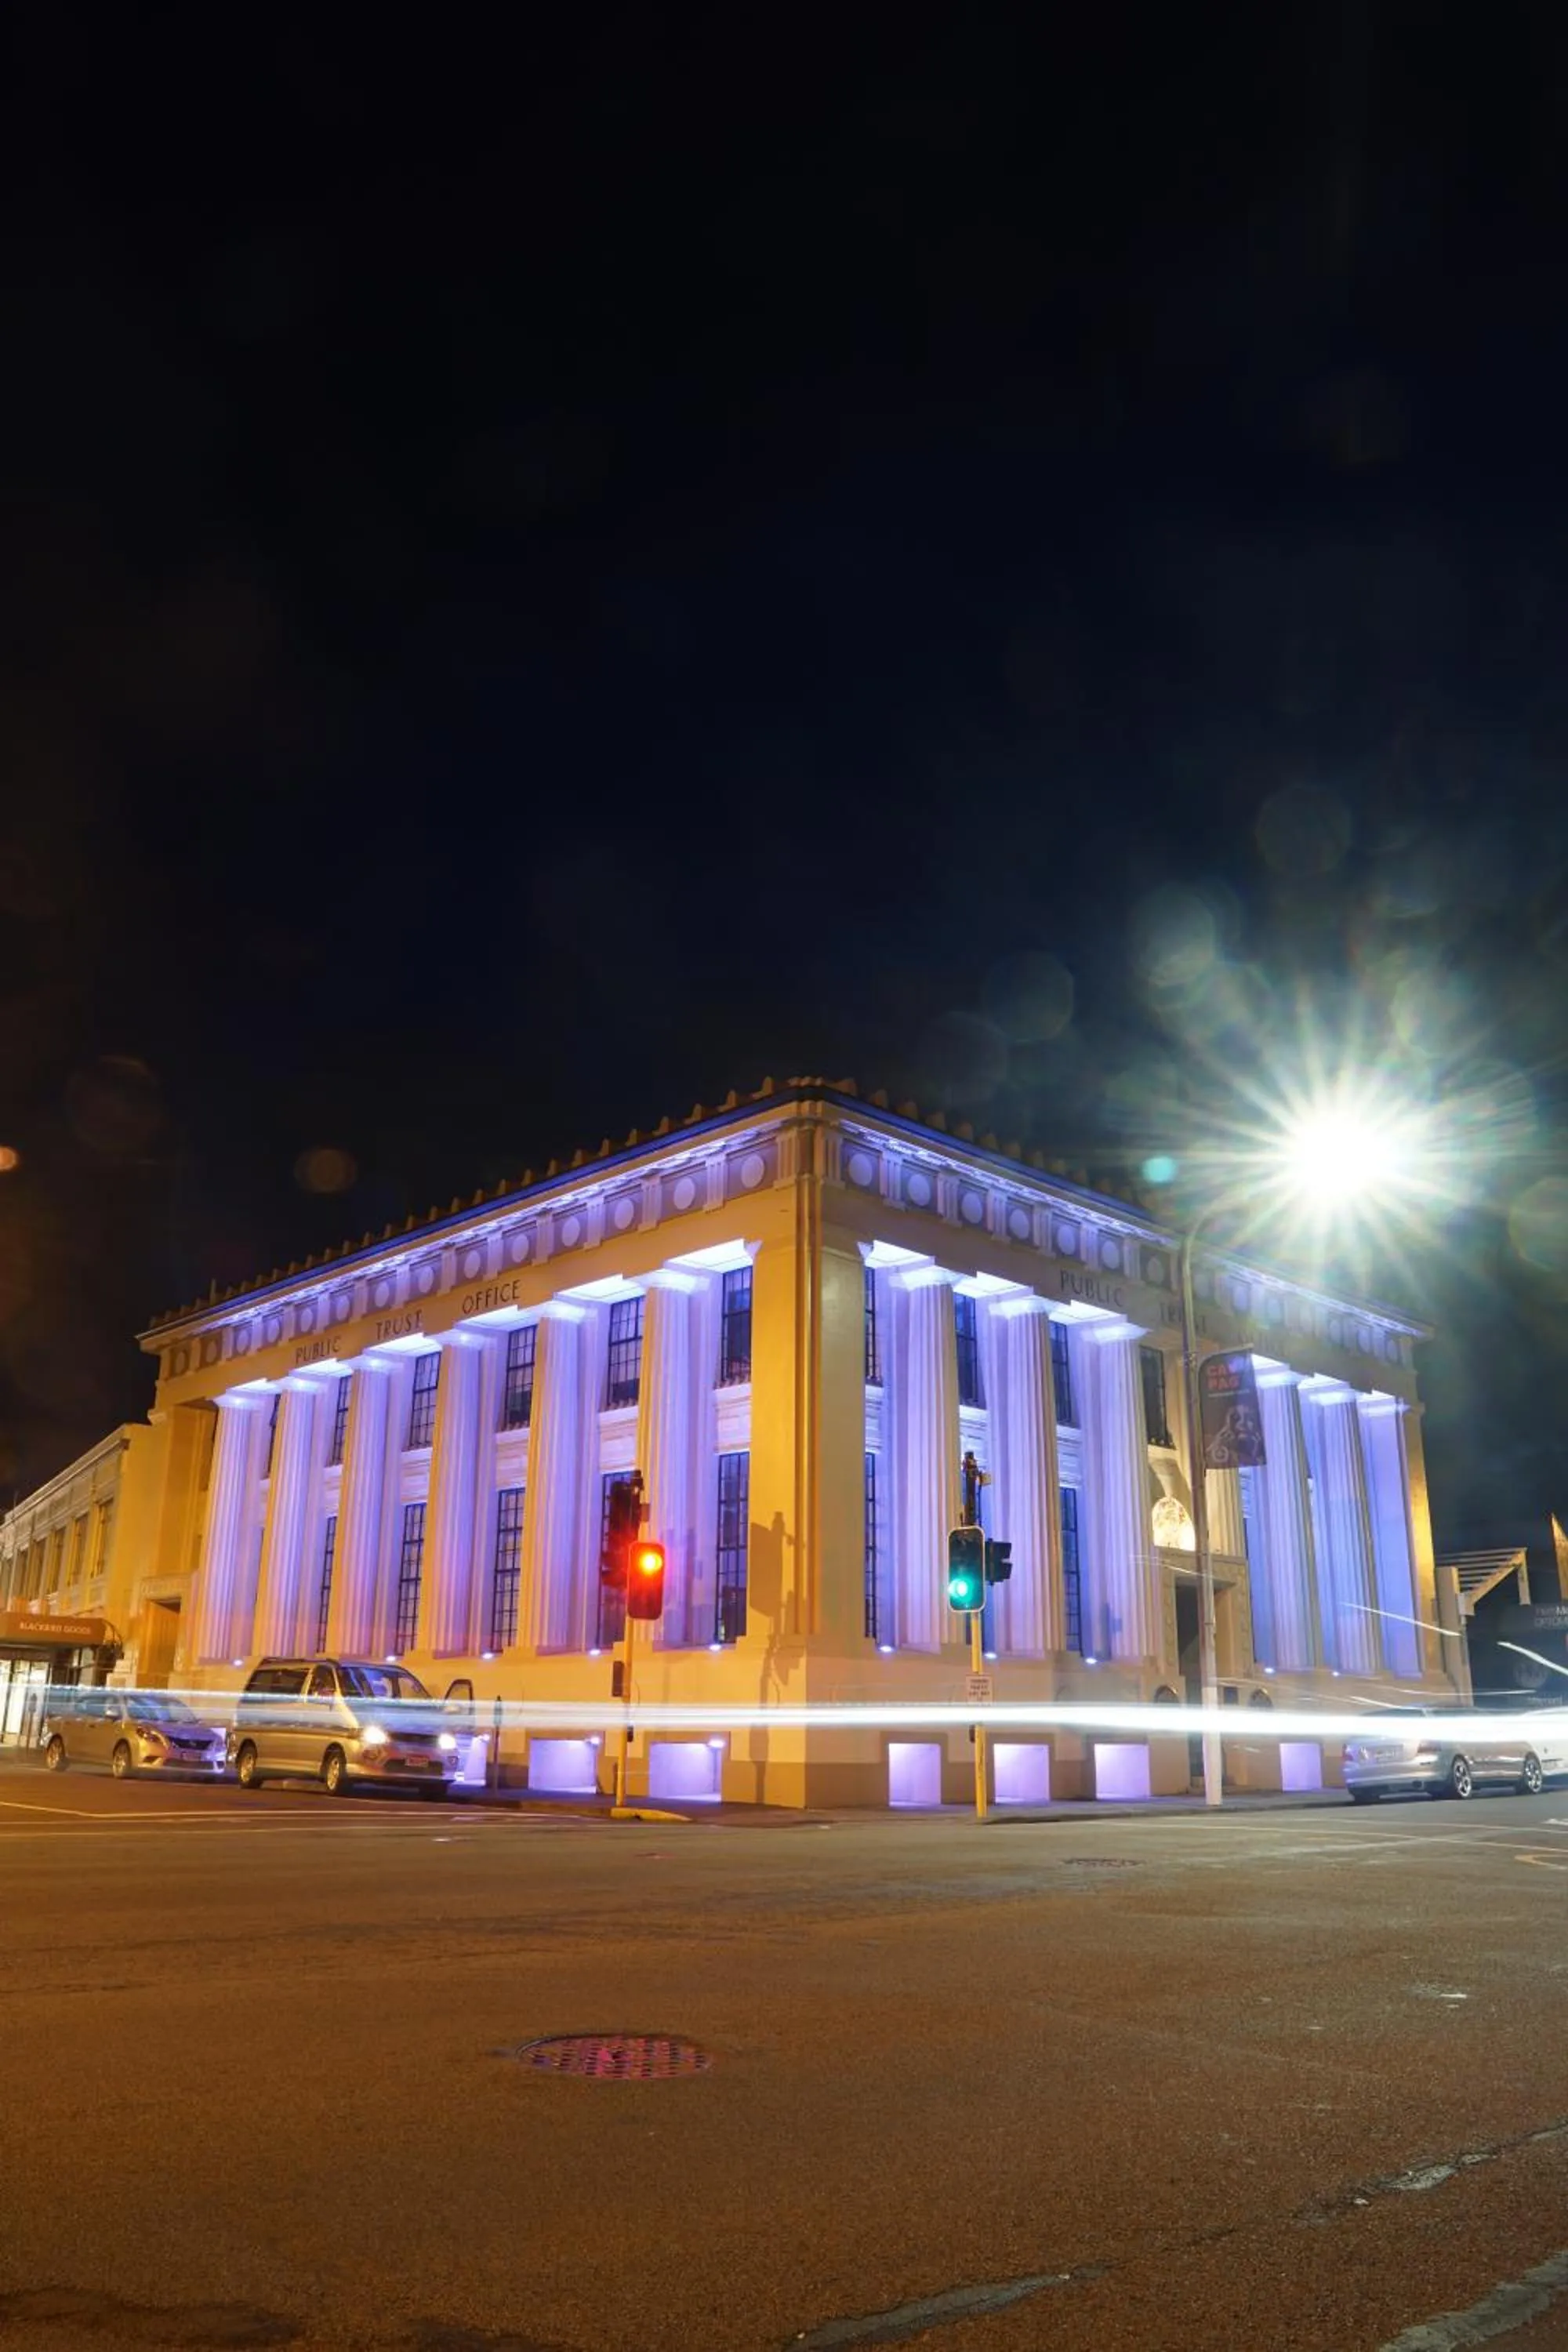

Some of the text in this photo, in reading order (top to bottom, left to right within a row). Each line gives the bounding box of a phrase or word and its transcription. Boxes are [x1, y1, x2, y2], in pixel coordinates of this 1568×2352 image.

[1060, 1269, 1123, 1307] PUBLIC
[296, 1279, 521, 1364] PUBLIC TRUST OFFICE
